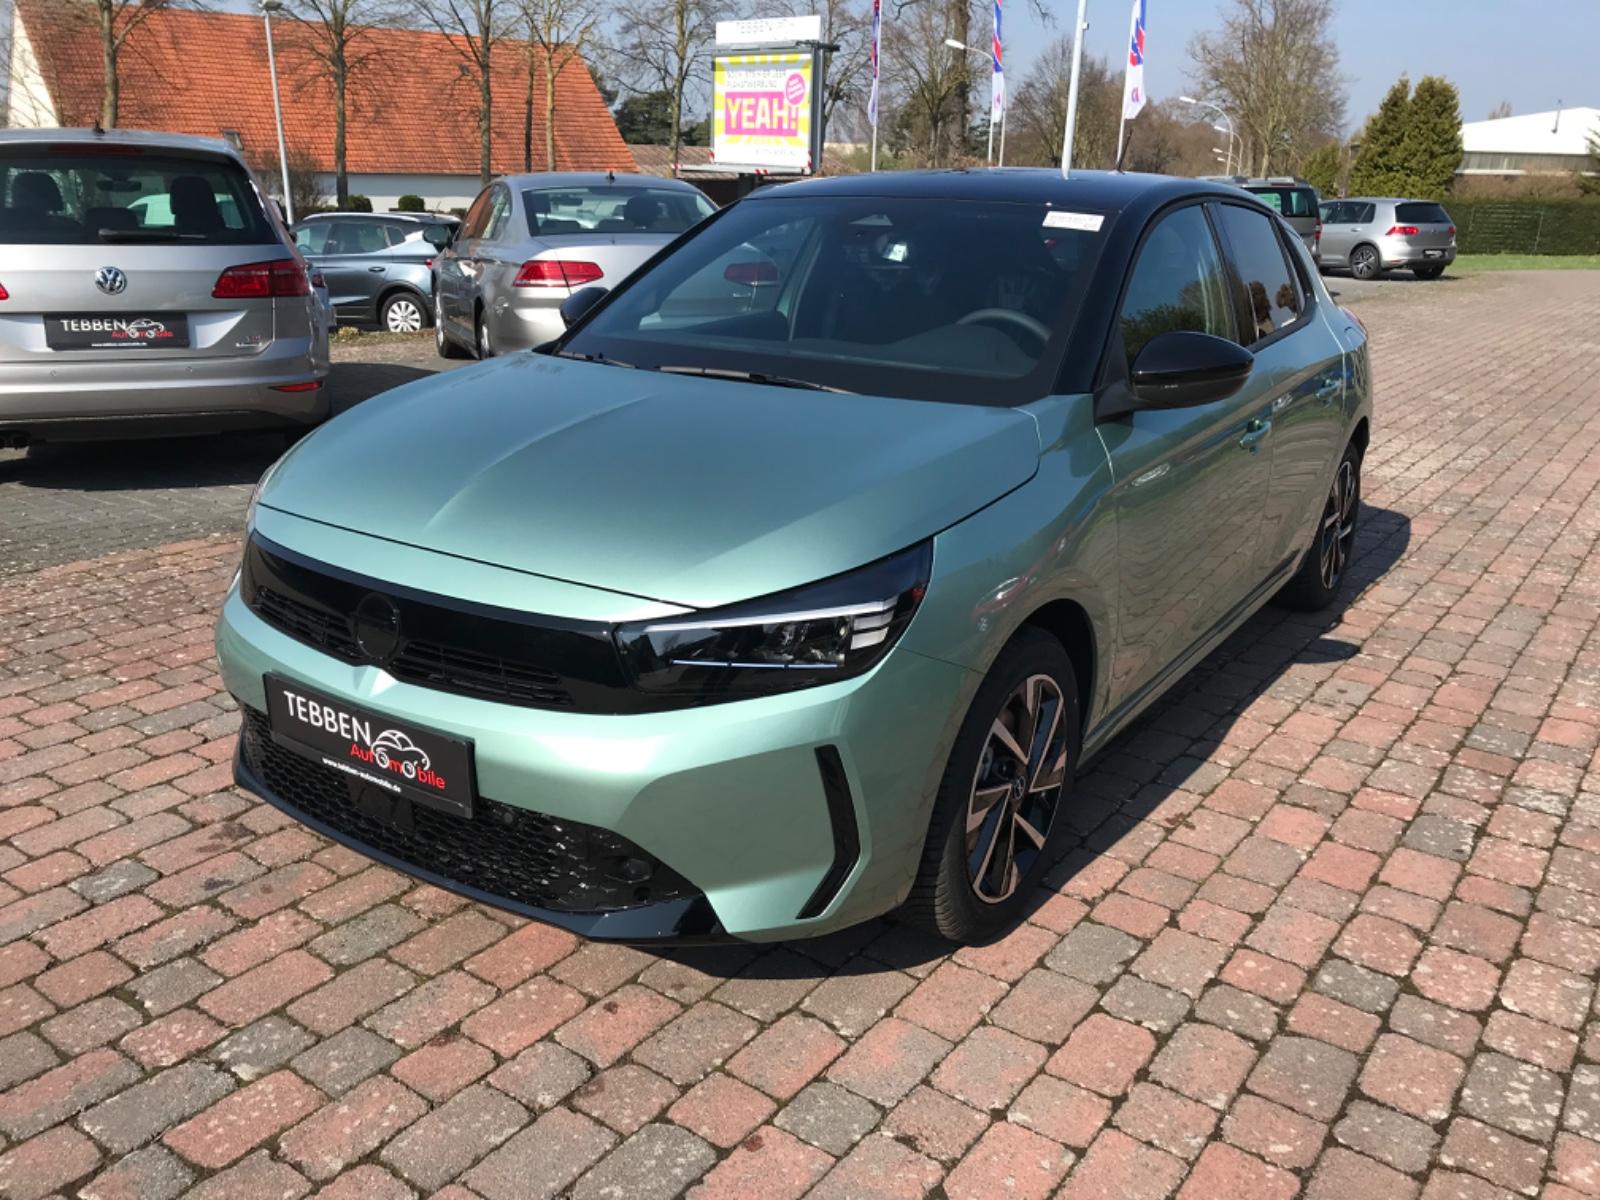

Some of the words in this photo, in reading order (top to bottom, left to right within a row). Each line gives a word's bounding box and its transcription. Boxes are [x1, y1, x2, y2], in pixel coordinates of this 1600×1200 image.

[726, 97, 798, 129] YEAH!
[60, 318, 128, 332] TEBBEN
[283, 690, 372, 747] TEBBEN
